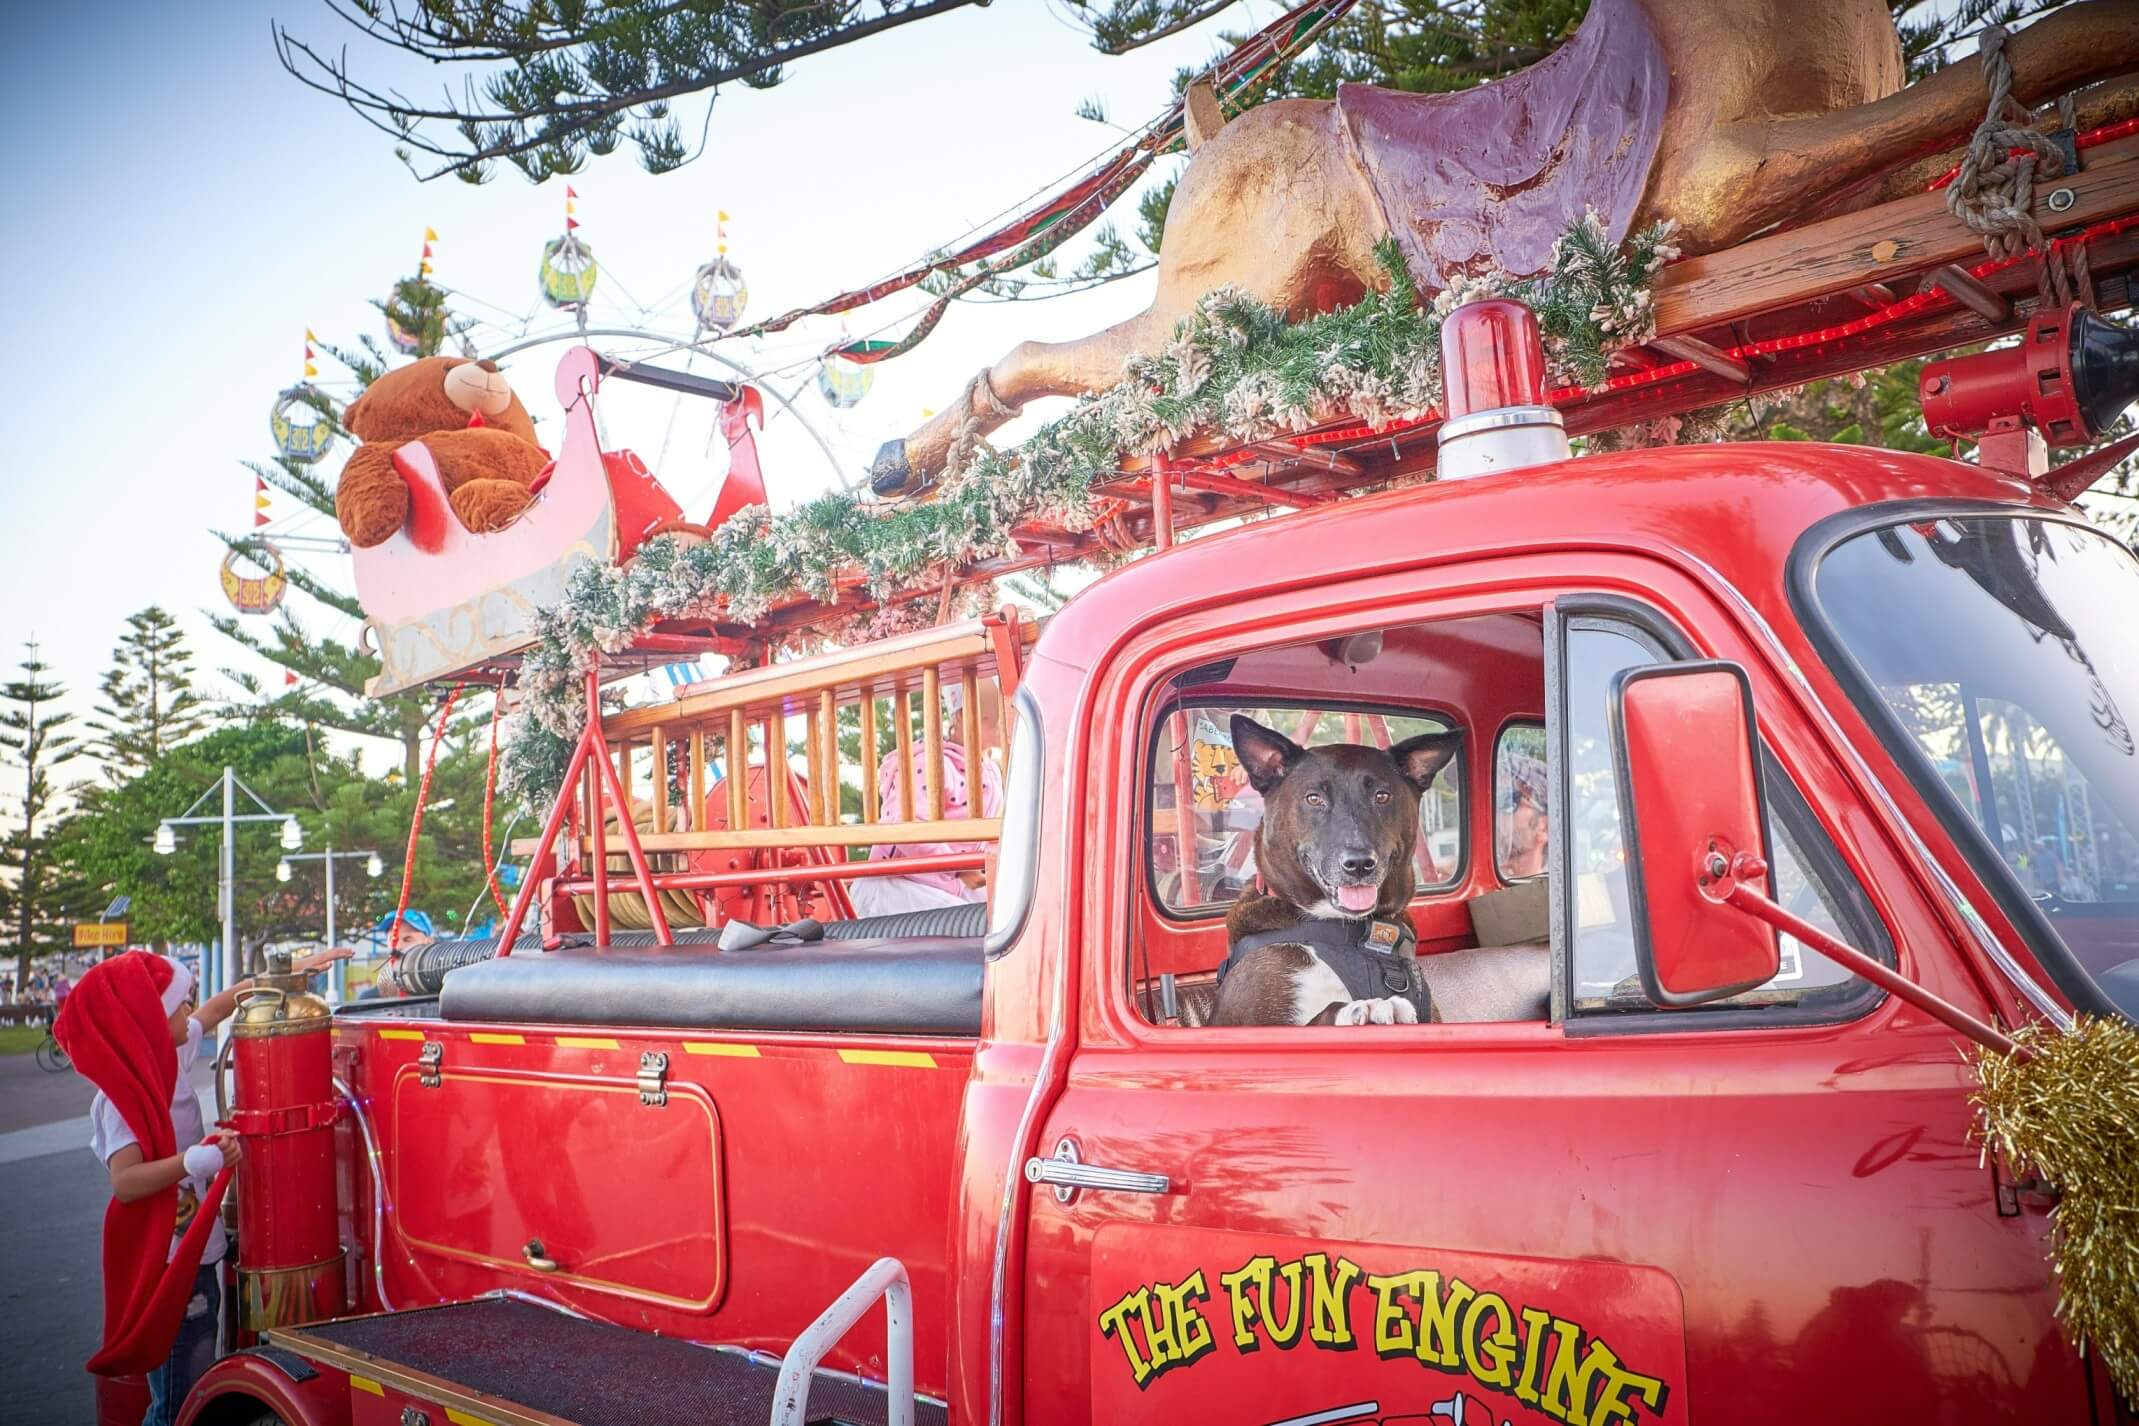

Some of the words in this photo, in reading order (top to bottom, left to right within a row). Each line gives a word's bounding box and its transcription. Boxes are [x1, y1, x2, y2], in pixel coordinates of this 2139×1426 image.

[1098, 1268, 1217, 1391] THE
[1220, 1252, 1363, 1354] FUN
[1366, 1269, 1670, 1426] ENGINE
